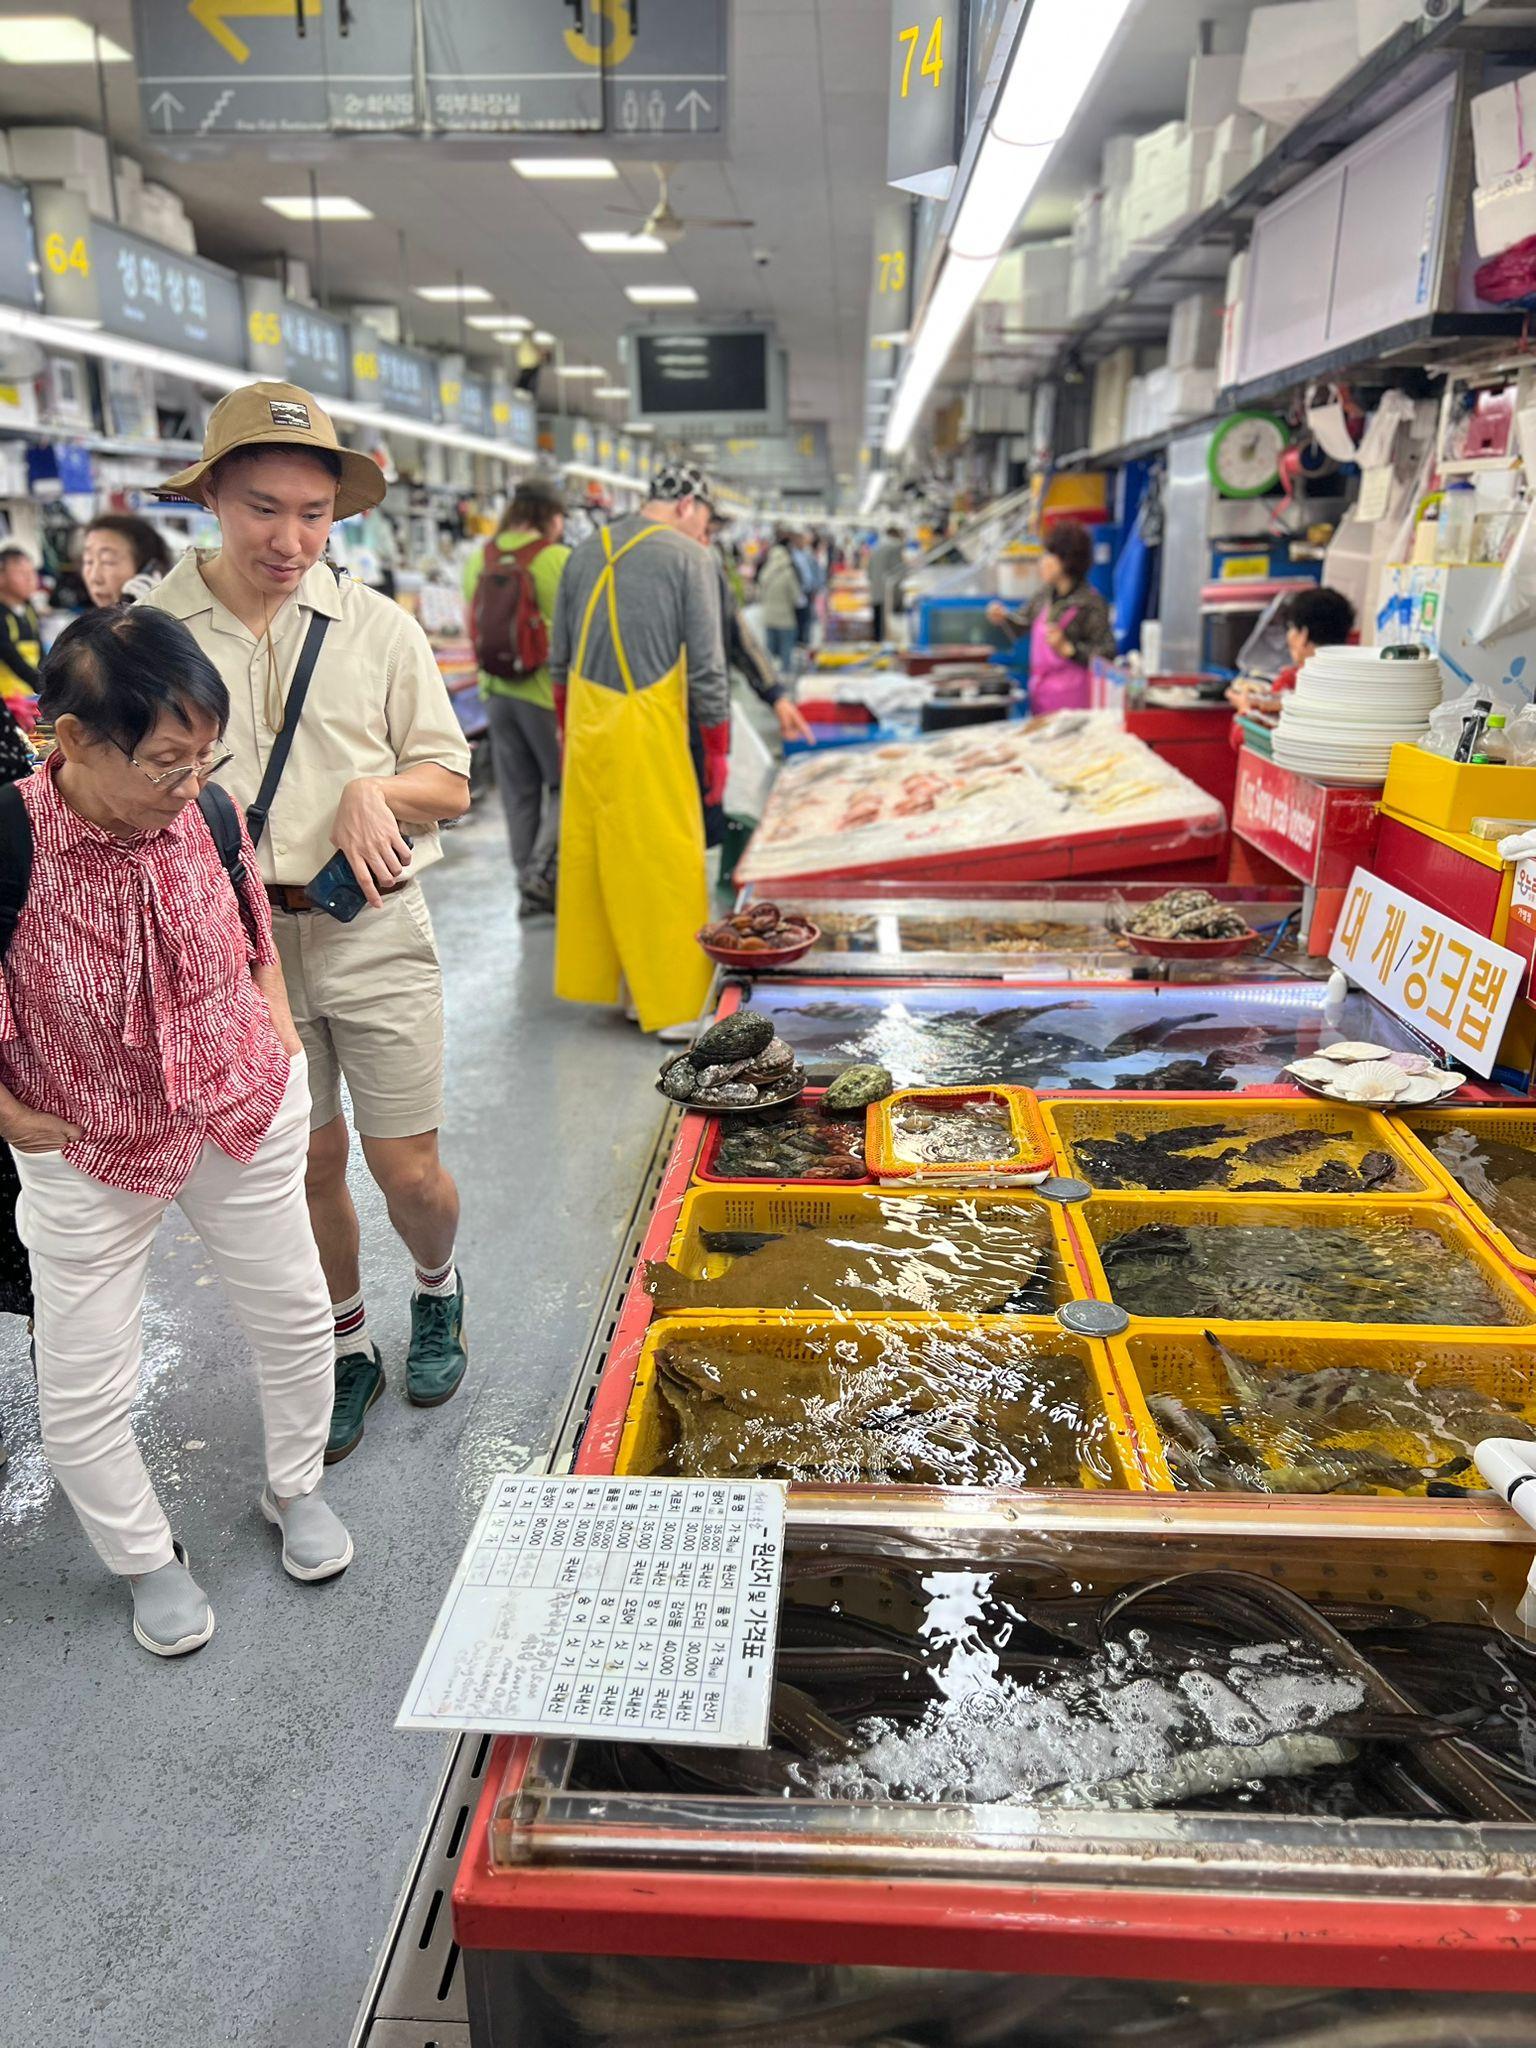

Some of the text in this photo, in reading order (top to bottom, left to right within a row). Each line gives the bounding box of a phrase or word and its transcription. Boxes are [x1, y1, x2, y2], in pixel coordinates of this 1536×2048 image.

[899, 16, 943, 98] 74
[45, 232, 89, 279] 64
[879, 251, 905, 293] 73
[248, 309, 282, 346] 65
[711, 1489, 725, 1505] 광어
[528, 1517, 548, 1546] 80,000
[549, 1517, 570, 1546] 30,000
[571, 1518, 591, 1547] 30,000
[599, 1518, 615, 1549] 100,000
[615, 1519, 634, 1549] 30,000
[636, 1520, 655, 1550] 35,000
[659, 1521, 677, 1551] 30,000
[681, 1521, 699, 1551] 30,000
[700, 1523, 713, 1551] 30,000
[710, 1523, 723, 1552] 35,000
[560, 1556, 580, 1582] 국내산
[628, 1559, 647, 1585] 국내산
[651, 1560, 669, 1586] 국내산
[674, 1560, 692, 1587] 국내산
[696, 1562, 714, 1589] 국내산
[719, 1563, 737, 1589] 원산지
[747, 1542, 776, 1587] 원산지
[746, 1590, 766, 1602] 및
[619, 1598, 638, 1625] 오징어
[667, 1600, 685, 1628] 감성돔
[690, 1601, 708, 1629] 도다리
[741, 1607, 768, 1659] 가격표
[658, 1639, 677, 1676] 40,000
[683, 1640, 702, 1677] 30,000
[547, 1681, 569, 1714] 국내산
[572, 1683, 594, 1715] 국내산
[598, 1684, 619, 1717] 국내산
[623, 1685, 644, 1718] 국내산
[649, 1687, 670, 1720] 국내산
[675, 1689, 694, 1722] 국내산
[700, 1691, 720, 1723] 원산지
